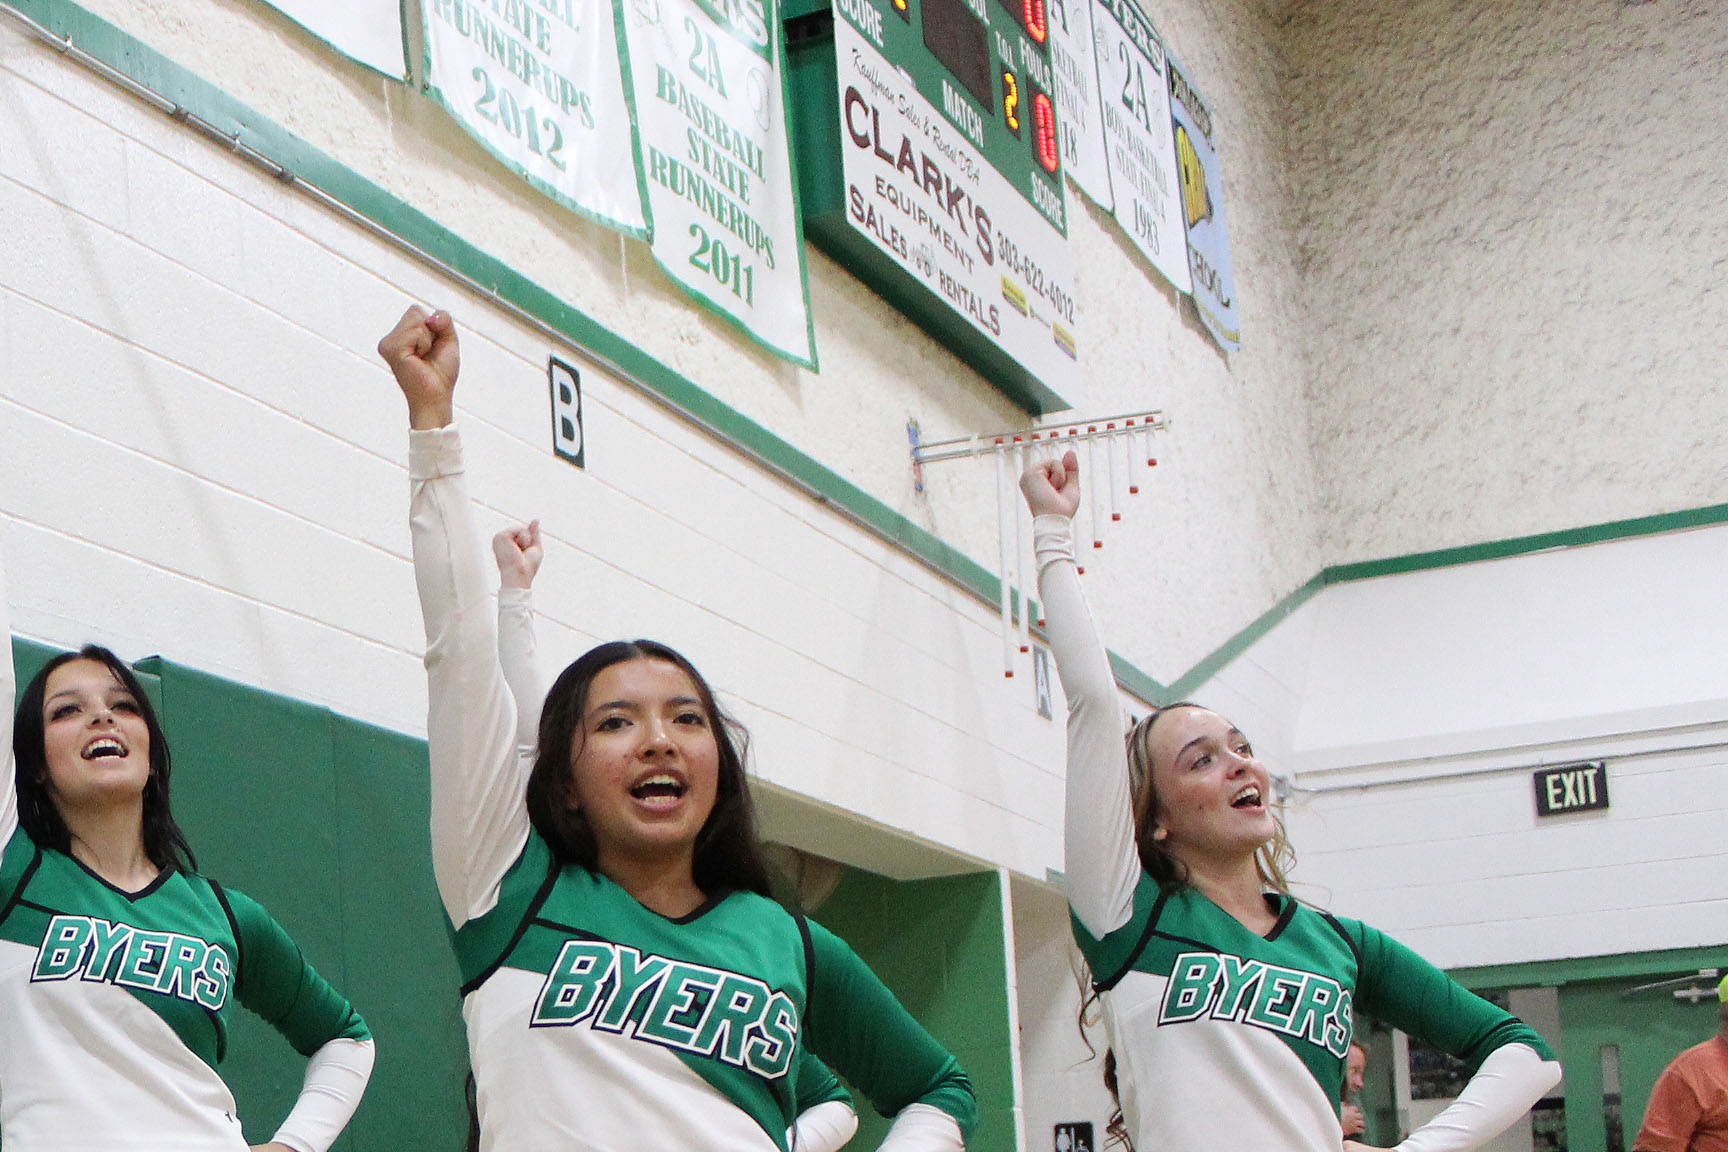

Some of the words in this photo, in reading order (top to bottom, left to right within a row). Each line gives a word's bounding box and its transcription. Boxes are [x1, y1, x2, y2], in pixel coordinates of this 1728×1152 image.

[684, 15, 729, 100] 2A
[837, 0, 884, 48] CORE
[472, 66, 567, 172] 2012
[656, 62, 766, 183] BASEBALL
[942, 79, 985, 148] MATCH
[1004, 72, 1019, 130] 2
[1119, 40, 1152, 135] 2A
[648, 143, 776, 271] RUNNERUPS
[687, 126, 751, 206] STATE
[845, 86, 994, 267] CLARK'S
[1030, 171, 1065, 231] SCORE
[688, 223, 753, 308] 2011
[850, 183, 908, 260] SALES
[940, 269, 1001, 336] RENTALS
[875, 174, 974, 274] EQUIPMENT
[998, 230, 1074, 326] 303-622-4012
[552, 362, 582, 458] B
[1545, 768, 1599, 809] EXIT
[30, 914, 230, 1012] BYERS
[529, 940, 799, 1080] BYERS
[1157, 951, 1353, 1059] BYERS
